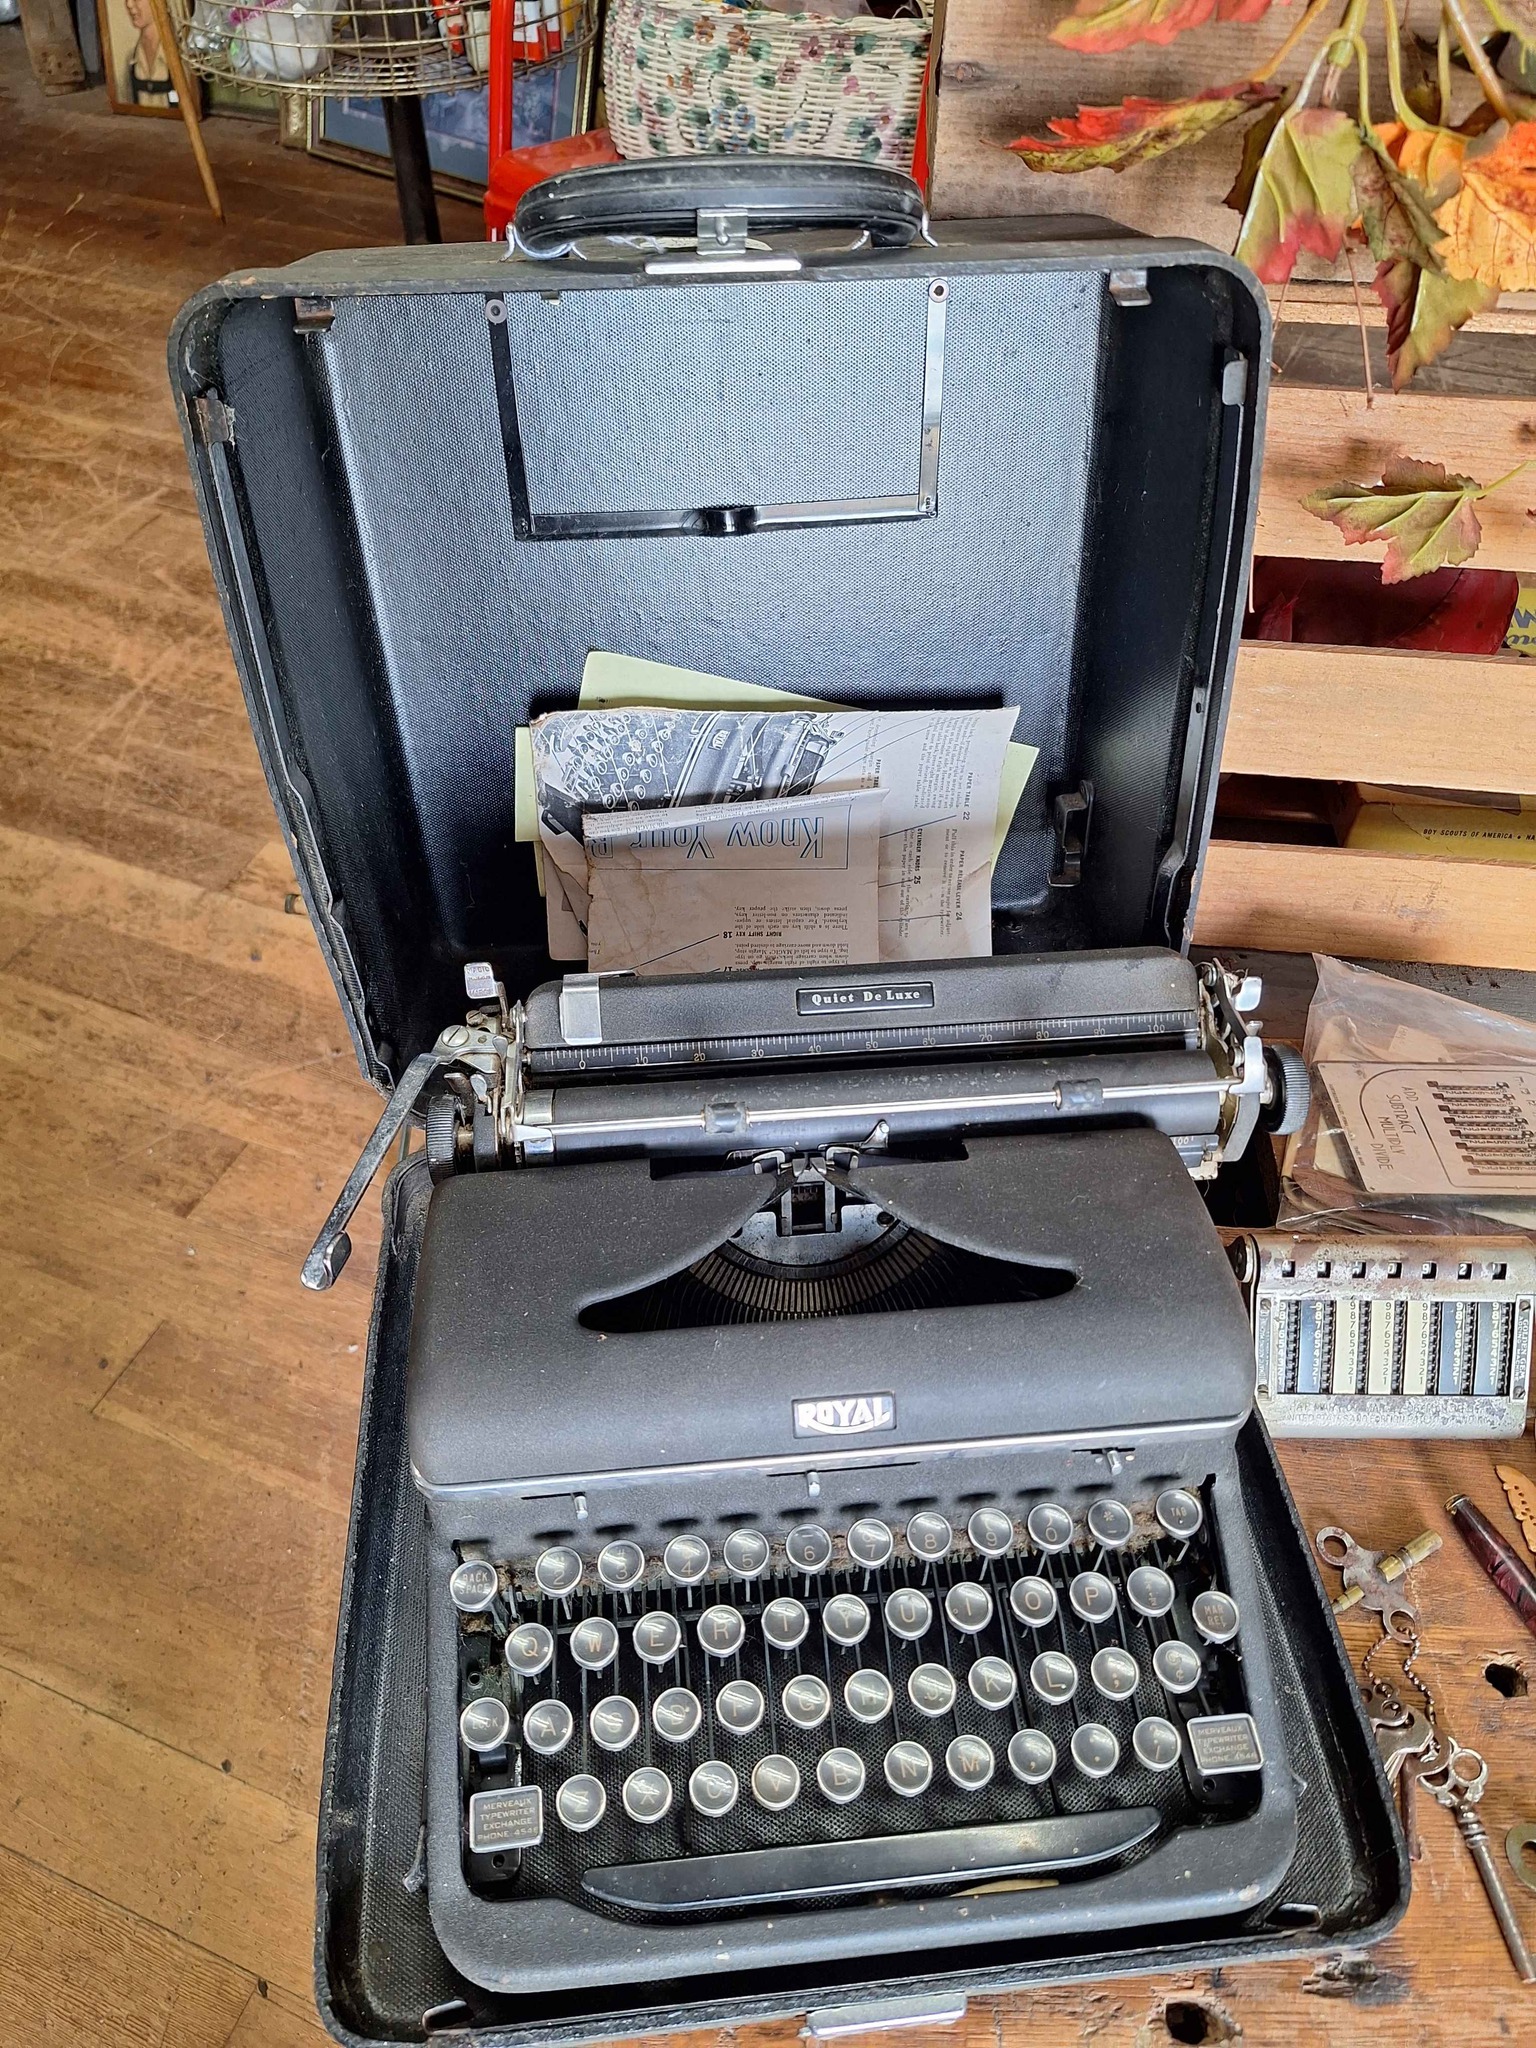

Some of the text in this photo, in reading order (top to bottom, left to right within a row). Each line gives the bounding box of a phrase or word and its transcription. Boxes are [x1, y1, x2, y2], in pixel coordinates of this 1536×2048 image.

[963, 812, 970, 821] 22
[630, 817, 824, 859] Know Your
[914, 876, 921, 884] 25
[956, 912, 962, 921] 24
[812, 990, 920, 1006] Quiet De Luxe
[579, 1023, 1166, 1070] 0 10 20 30 40 50 60 70 80 90 100
[1402, 1086, 1419, 1102] ADD
[1387, 1094, 1417, 1135] SUBTRACT
[1370, 1143, 1393, 1170] DIVIDE
[1422, 1263, 1467, 1275] 9 2
[1519, 1319, 1529, 1379] GOLDEN GEM
[797, 1397, 890, 1434] ROYAL
[1171, 1507, 1187, 1517] TAB
[925, 1533, 937, 1549] 8
[986, 1532, 997, 1547] 9
[1045, 1527, 1058, 1542] 0
[804, 1545, 815, 1561] 6
[865, 1544, 876, 1558] 7
[681, 1561, 693, 1576] 4
[742, 1553, 753, 1568] 5
[462, 1572, 488, 1582] BACK
[553, 1570, 565, 1585] 2
[616, 1565, 628, 1580] 3
[459, 1584, 490, 1594] SPACE
[1084, 1587, 1099, 1607] P
[965, 1597, 972, 1617] I
[1024, 1592, 1041, 1610] O
[1204, 1604, 1224, 1615] MAR
[839, 1608, 853, 1628] Y
[900, 1604, 915, 1623] U
[650, 1628, 665, 1648] E
[713, 1621, 729, 1641] R
[521, 1637, 538, 1657] Q
[588, 1634, 602, 1653] W
[983, 1672, 1001, 1693] K
[1045, 1667, 1066, 1689] L
[798, 1690, 816, 1712] G
[670, 1704, 686, 1726] D
[541, 1715, 557, 1738] A
[900, 1757, 918, 1779] N
[958, 1753, 980, 1773] M
[832, 1762, 852, 1786] B
[483, 1797, 532, 1810] MERVEAUX
[573, 1791, 589, 1813] Z
[480, 1807, 535, 1821] TYPEWRITER
[483, 1817, 533, 1831] EXCHANGE
[477, 1831, 509, 1840] PHONE
